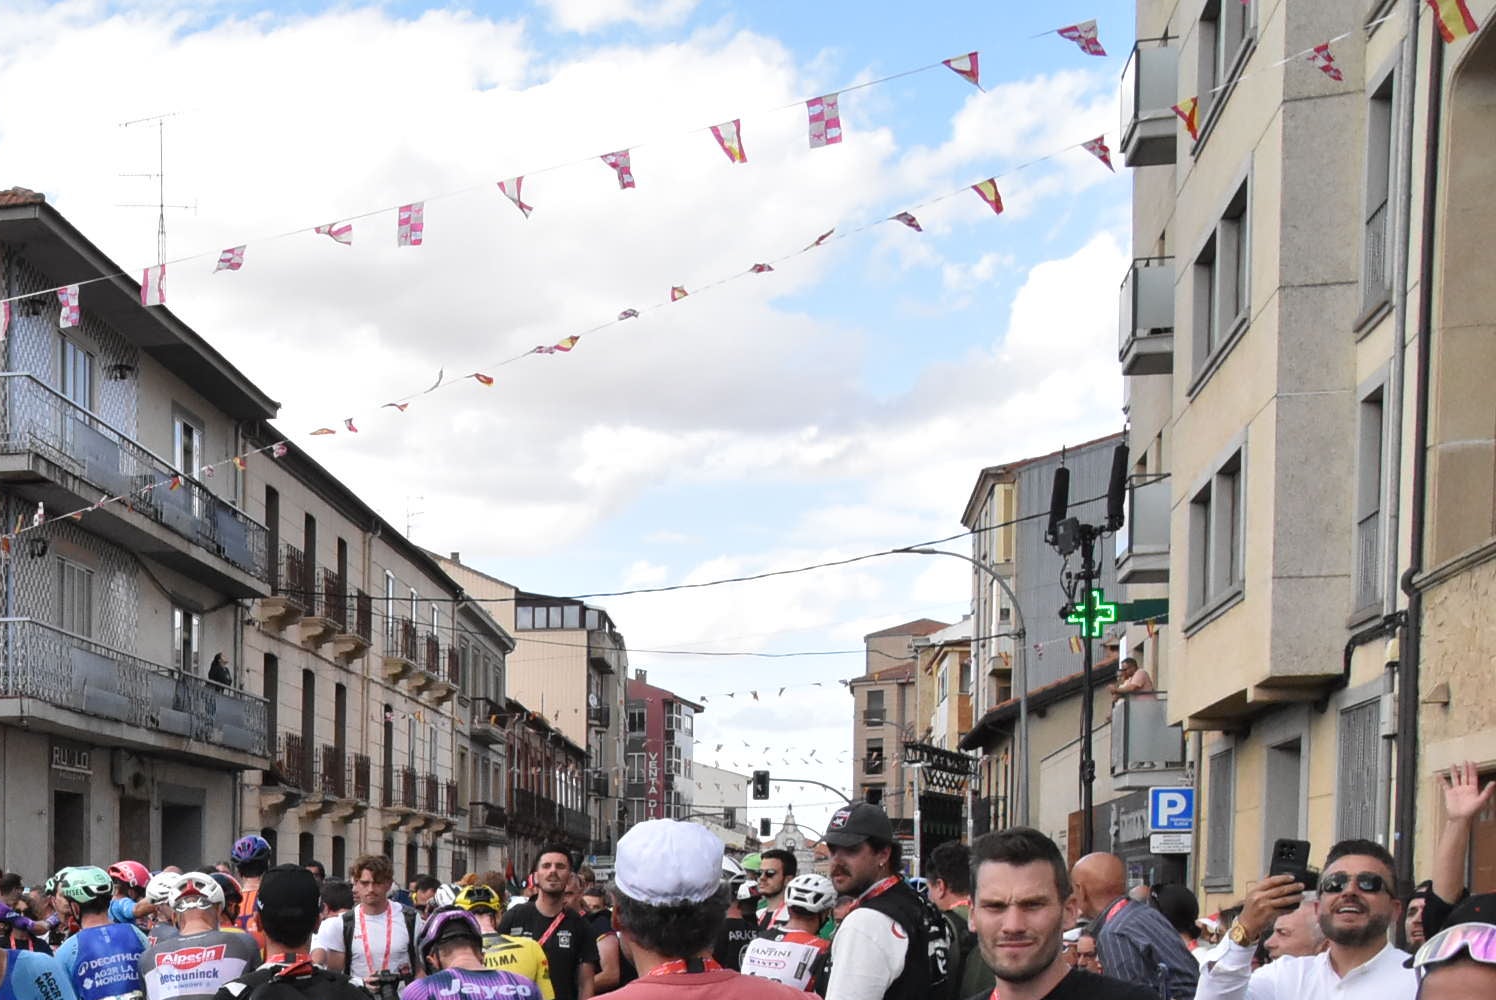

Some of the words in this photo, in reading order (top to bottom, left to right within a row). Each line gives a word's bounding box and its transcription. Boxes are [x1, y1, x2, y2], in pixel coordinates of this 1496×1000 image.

[648, 752, 658, 793] VENTA
[1158, 792, 1187, 827] P
[161, 949, 216, 966] Alpecin
[483, 953, 518, 968] VISMA
[94, 967, 120, 979] AG2R
[122, 965, 135, 974] LA
[440, 978, 532, 999] Jayco
